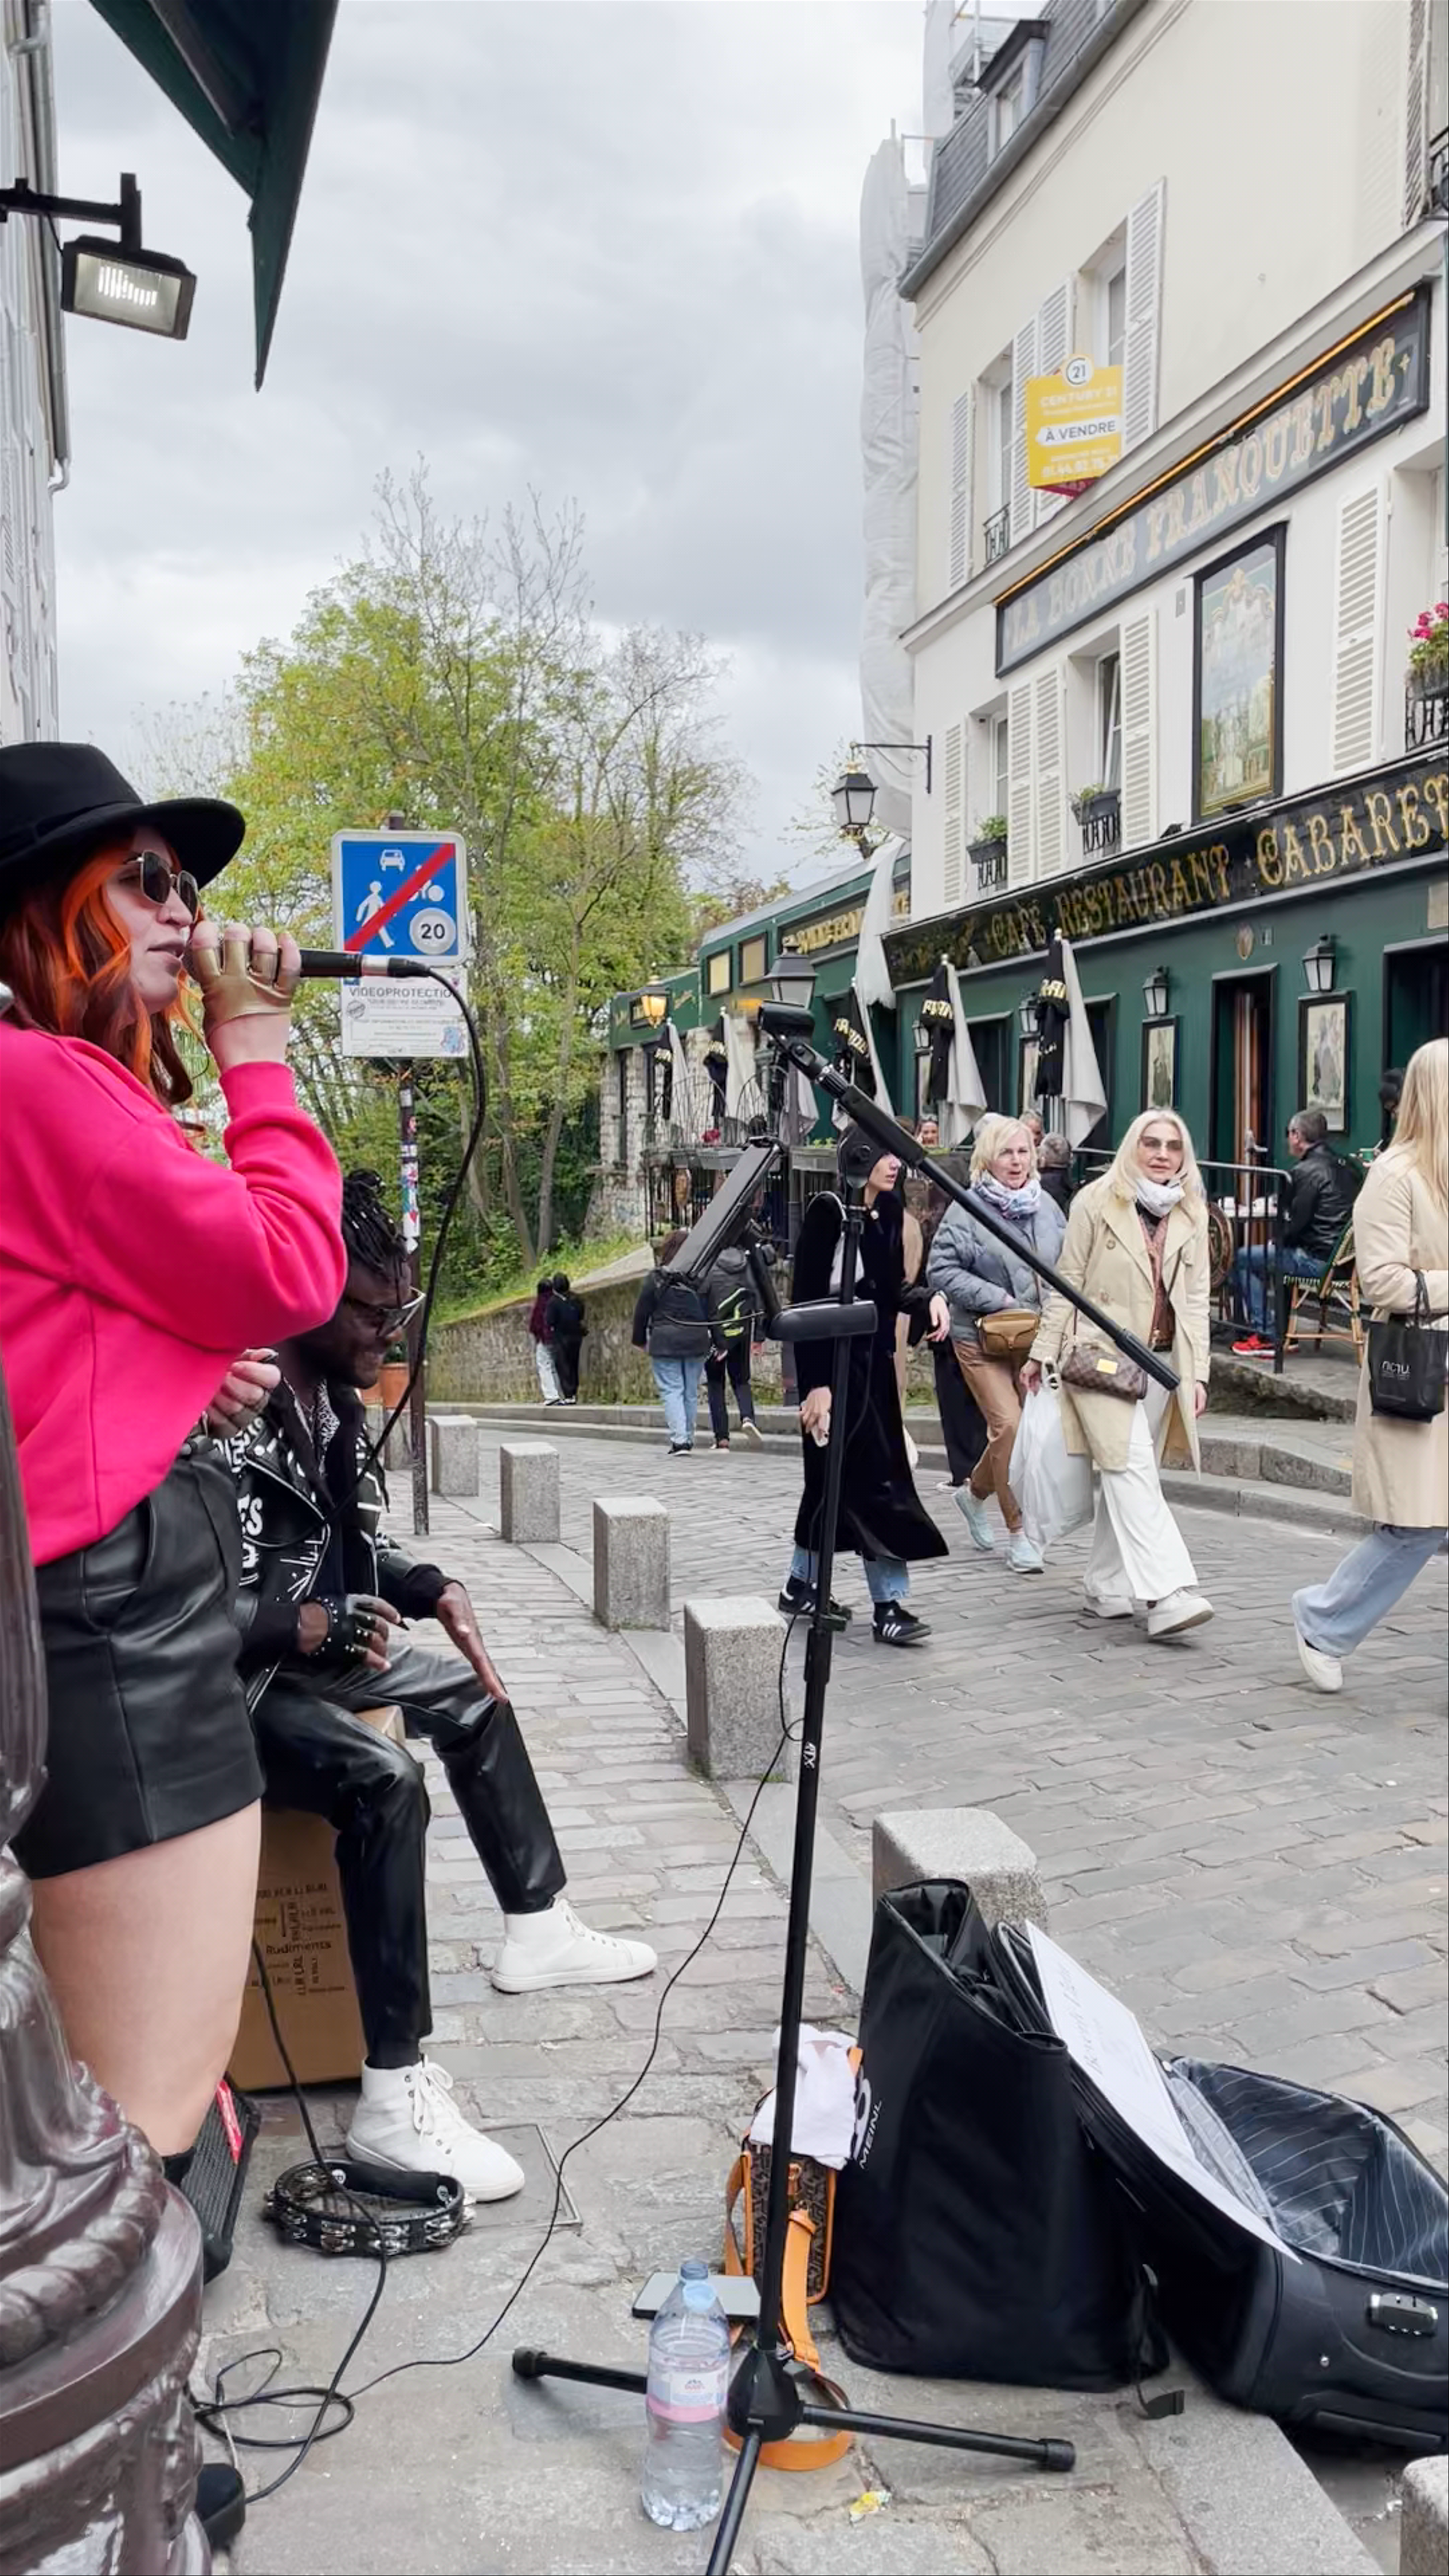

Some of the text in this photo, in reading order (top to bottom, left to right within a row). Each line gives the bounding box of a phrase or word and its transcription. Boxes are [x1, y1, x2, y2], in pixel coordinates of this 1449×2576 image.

[1072, 365, 1086, 378] 21
[1046, 421, 1116, 441] À VENDRE
[1048, 521, 1136, 625] BONNE
[1146, 338, 1395, 561] FRANQUETTE
[1055, 844, 1230, 936] RESTAURANT
[1257, 773, 1448, 885] CABARET
[421, 923, 445, 940] 20
[349, 987, 453, 998] VIDEOPROTECTIO
[859, 2099, 882, 2170] MEINL
